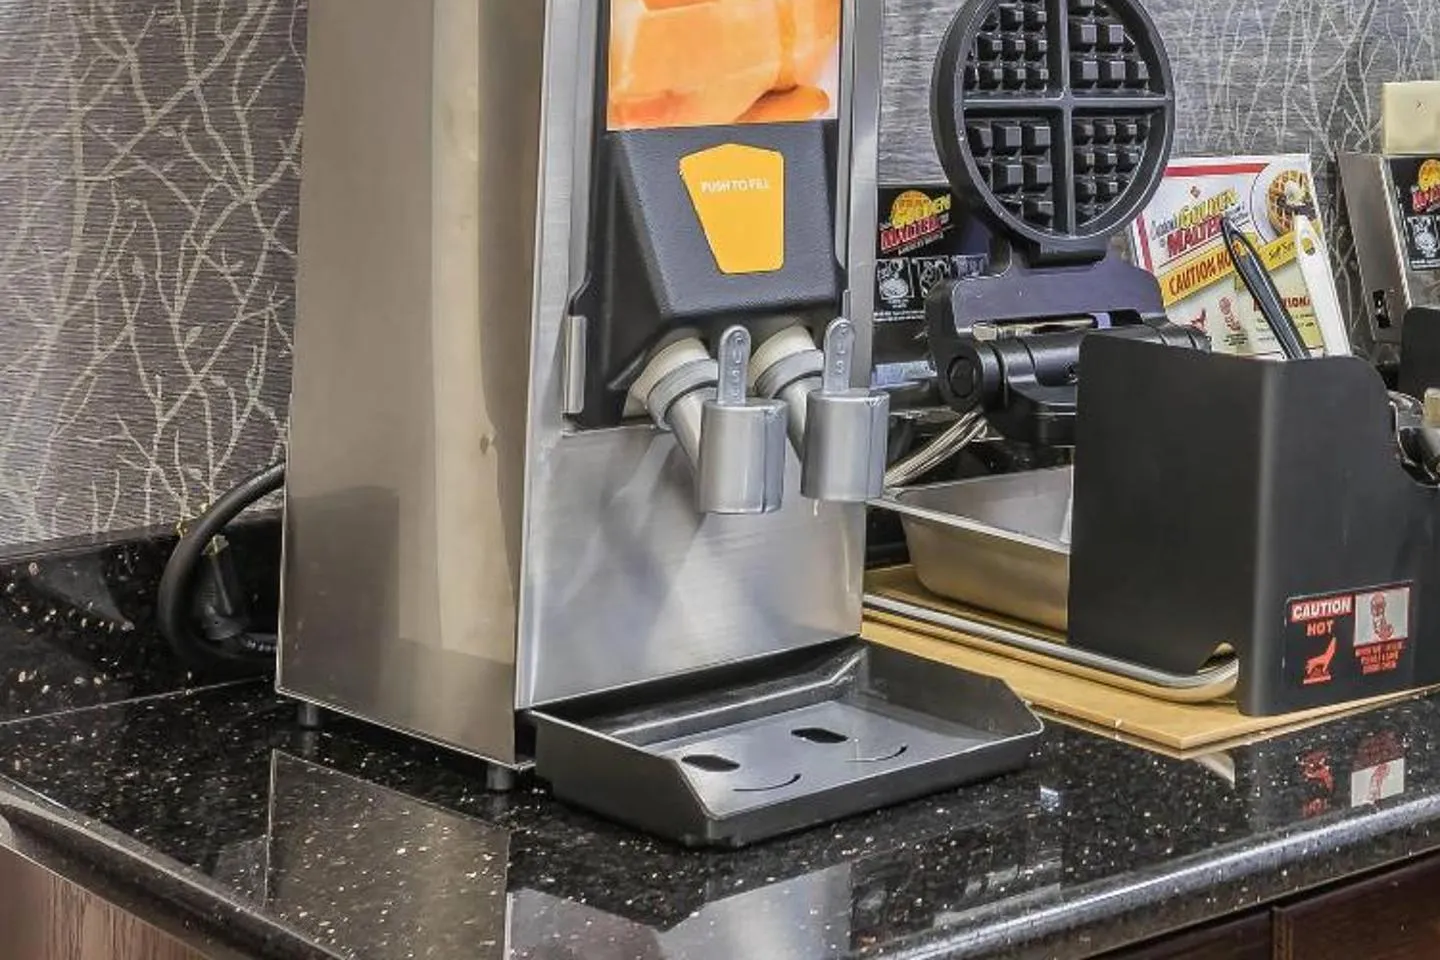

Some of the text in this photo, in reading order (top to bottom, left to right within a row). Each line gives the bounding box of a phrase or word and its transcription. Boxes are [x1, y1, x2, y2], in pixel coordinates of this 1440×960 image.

[701, 178, 770, 193] PUSH TO FILL
[1168, 258, 1216, 296] CAUTION
[1292, 596, 1352, 620] CAUTION
[1306, 619, 1334, 637] HOT
